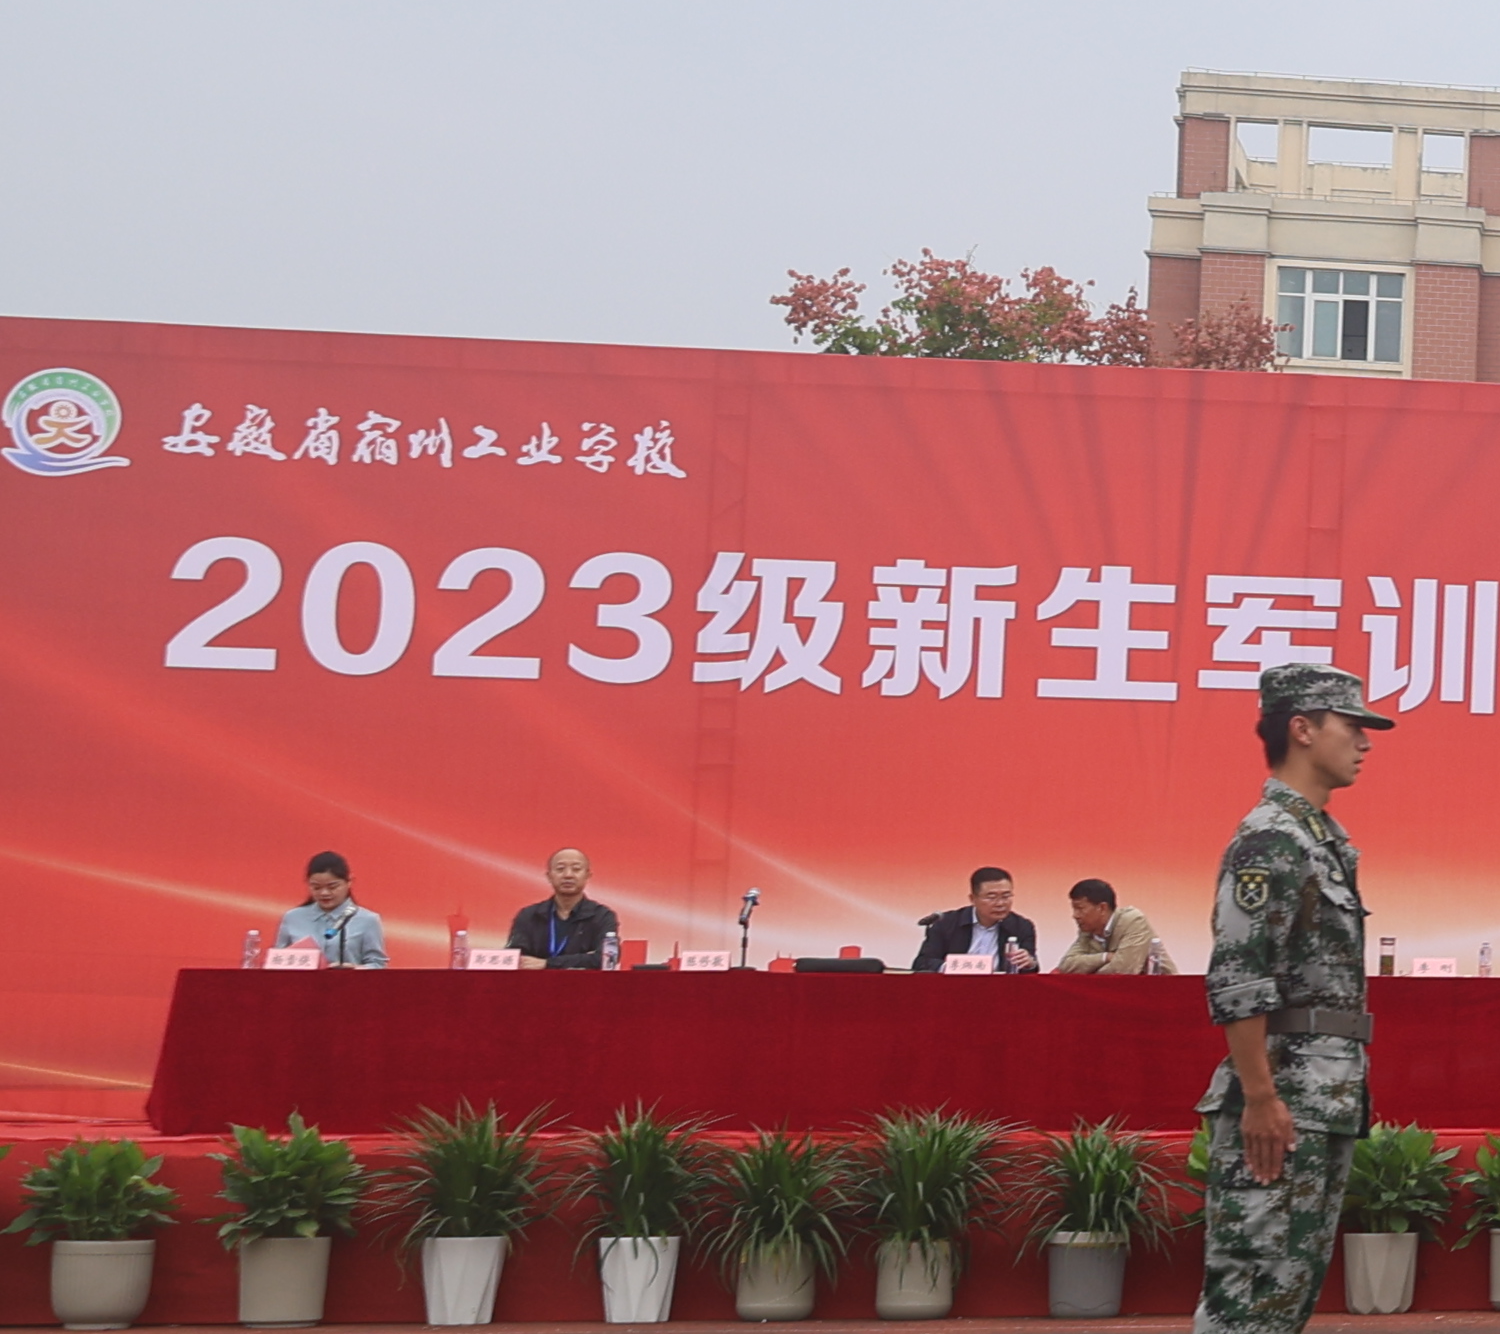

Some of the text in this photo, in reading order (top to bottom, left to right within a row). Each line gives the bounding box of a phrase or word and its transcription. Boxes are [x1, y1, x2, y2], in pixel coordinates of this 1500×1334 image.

[162, 403, 687, 478] 安徽省宿州工业学校
